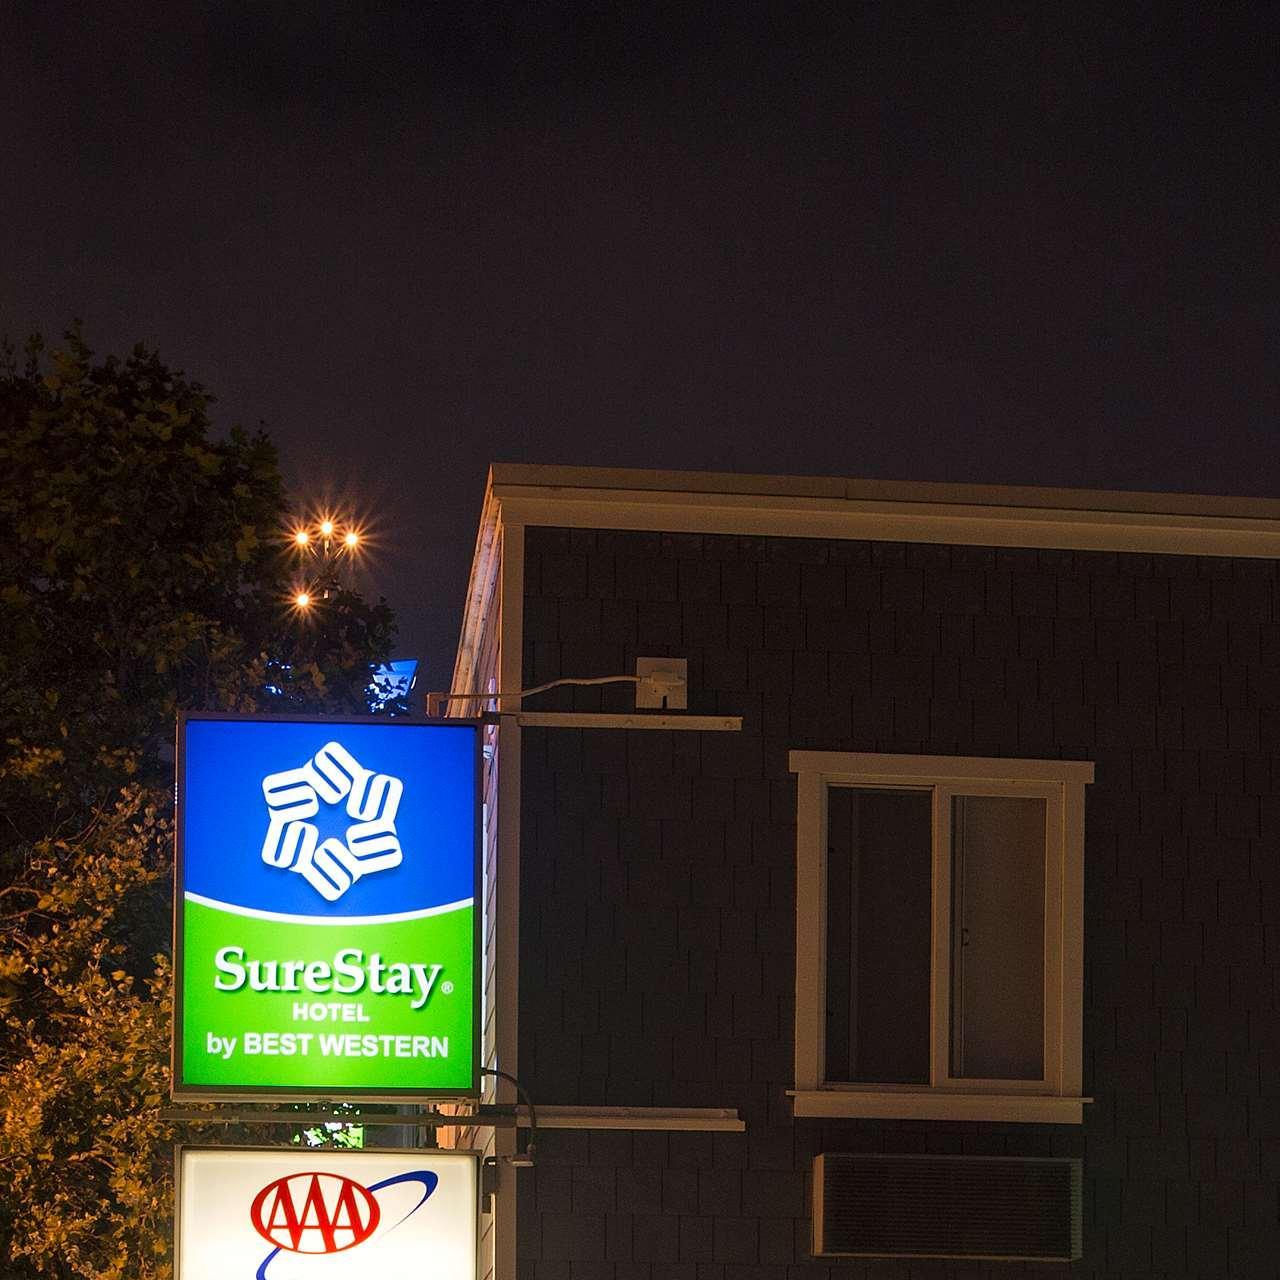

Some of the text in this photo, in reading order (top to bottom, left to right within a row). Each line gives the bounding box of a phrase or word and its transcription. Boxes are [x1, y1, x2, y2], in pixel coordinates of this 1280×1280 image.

[213, 946, 443, 1010] SureStay
[292, 1002, 370, 1023] HOTEL
[207, 1032, 449, 1060] by BEST WESTERN
[265, 1173, 365, 1253] AAA
